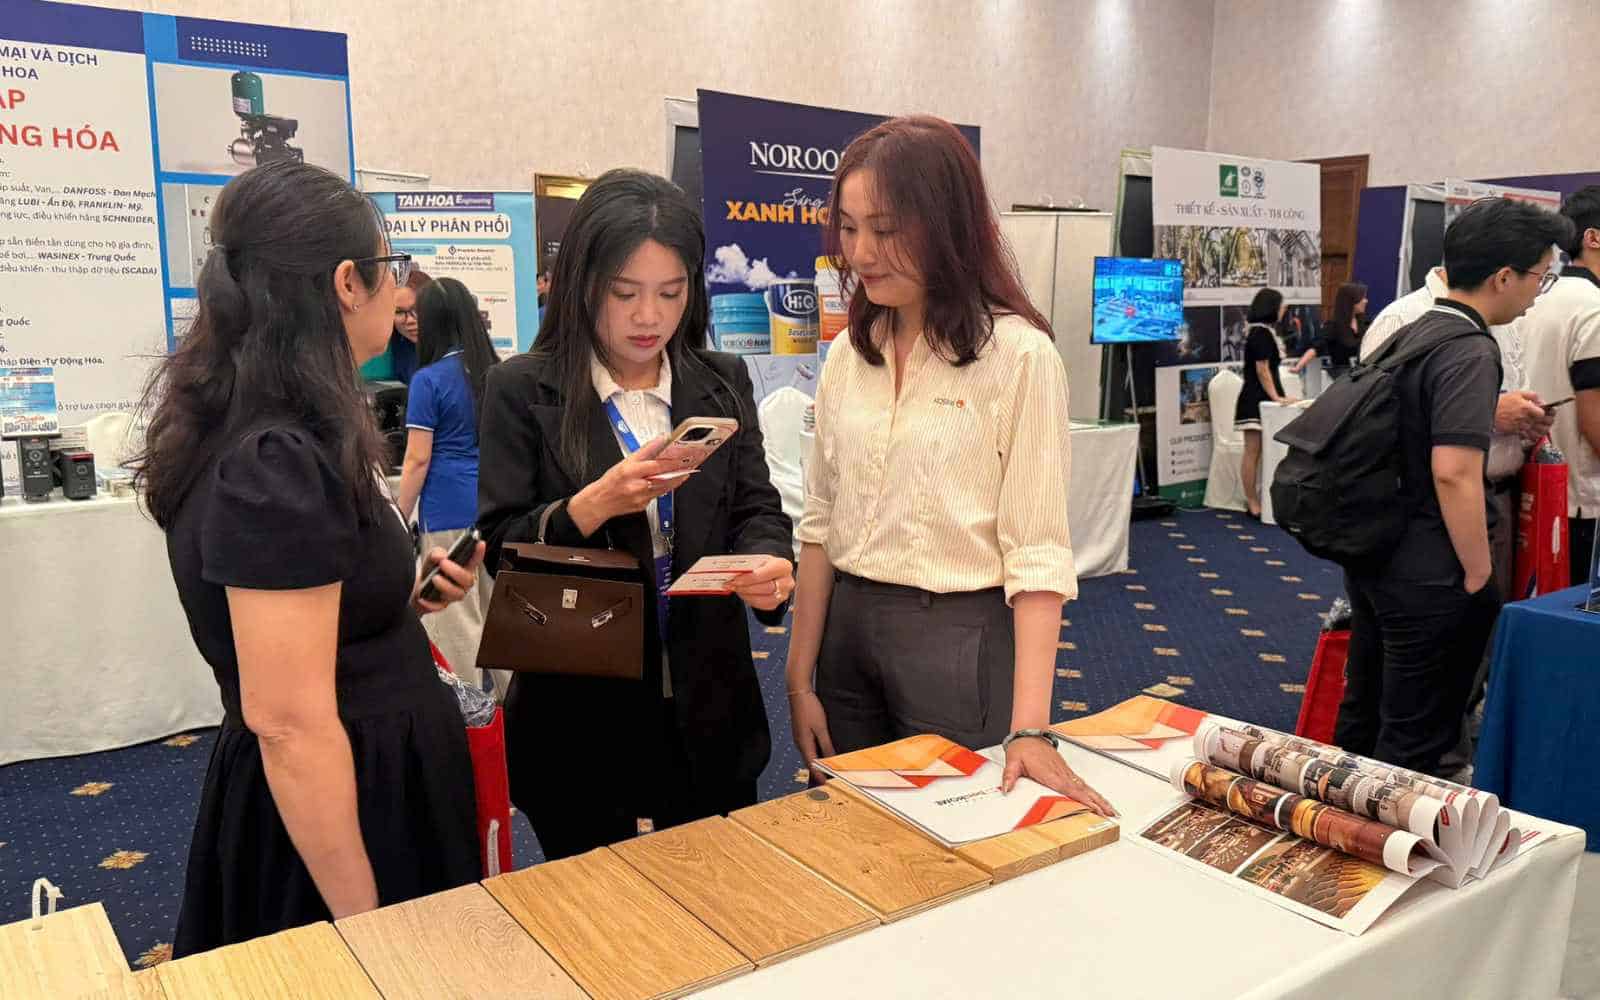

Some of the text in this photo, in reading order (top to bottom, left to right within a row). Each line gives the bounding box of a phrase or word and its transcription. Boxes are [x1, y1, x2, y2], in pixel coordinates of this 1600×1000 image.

[31, 47, 53, 62] VÀ
[57, 51, 98, 66] DỊCH
[2, 65, 39, 80] HOA
[52, 123, 120, 152] HÓA
[63, 186, 106, 196] DANFOSS
[397, 194, 424, 207] TAN
[426, 194, 455, 207] HOA
[726, 200, 794, 224] XANH
[410, 216, 429, 233] LÝ
[431, 217, 471, 233] PHÂN
[474, 213, 509, 233] PHỐI
[38, 251, 80, 261] WASINEX
[87, 253, 112, 263] Trung
[113, 252, 136, 262] Quốc
[121, 266, 157, 276] (SCADA)
[6, 316, 31, 327] Quốc
